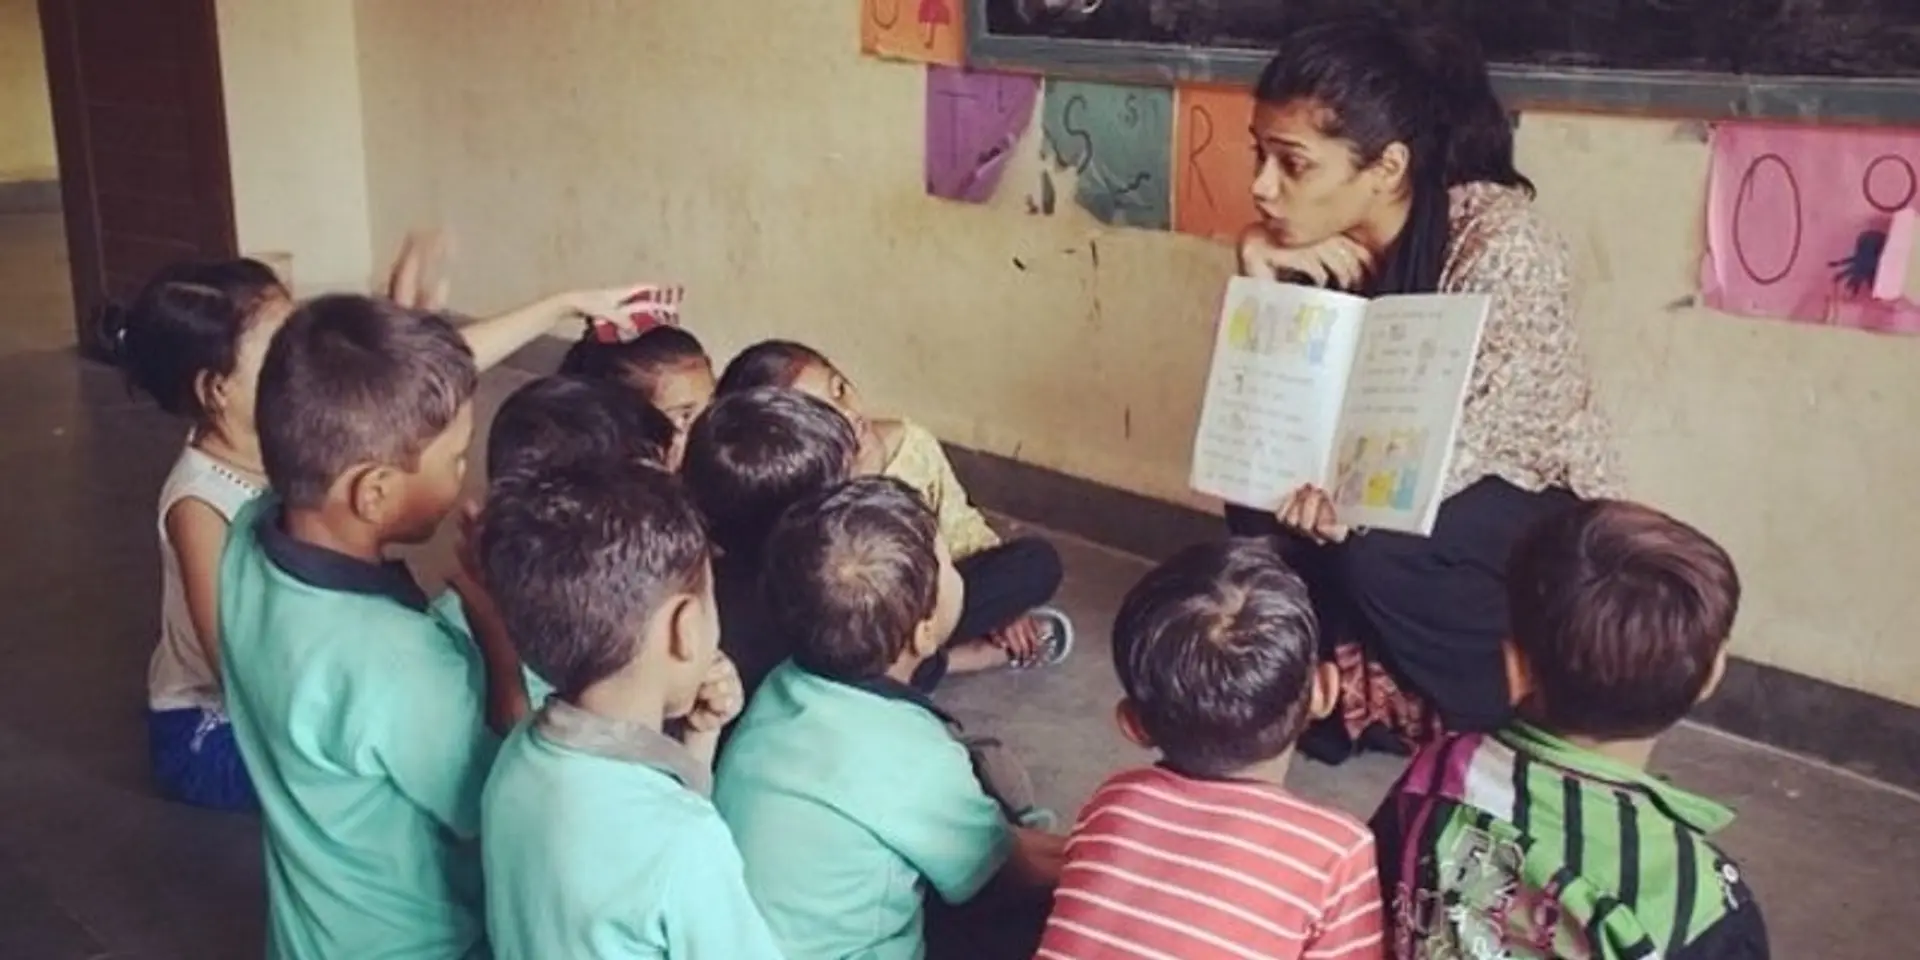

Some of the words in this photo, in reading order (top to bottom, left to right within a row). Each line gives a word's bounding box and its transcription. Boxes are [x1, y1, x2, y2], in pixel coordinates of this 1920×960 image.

[935, 90, 979, 170] T
[1043, 93, 1093, 176] S
[1187, 103, 1216, 210] R
[1733, 153, 1802, 286] O
